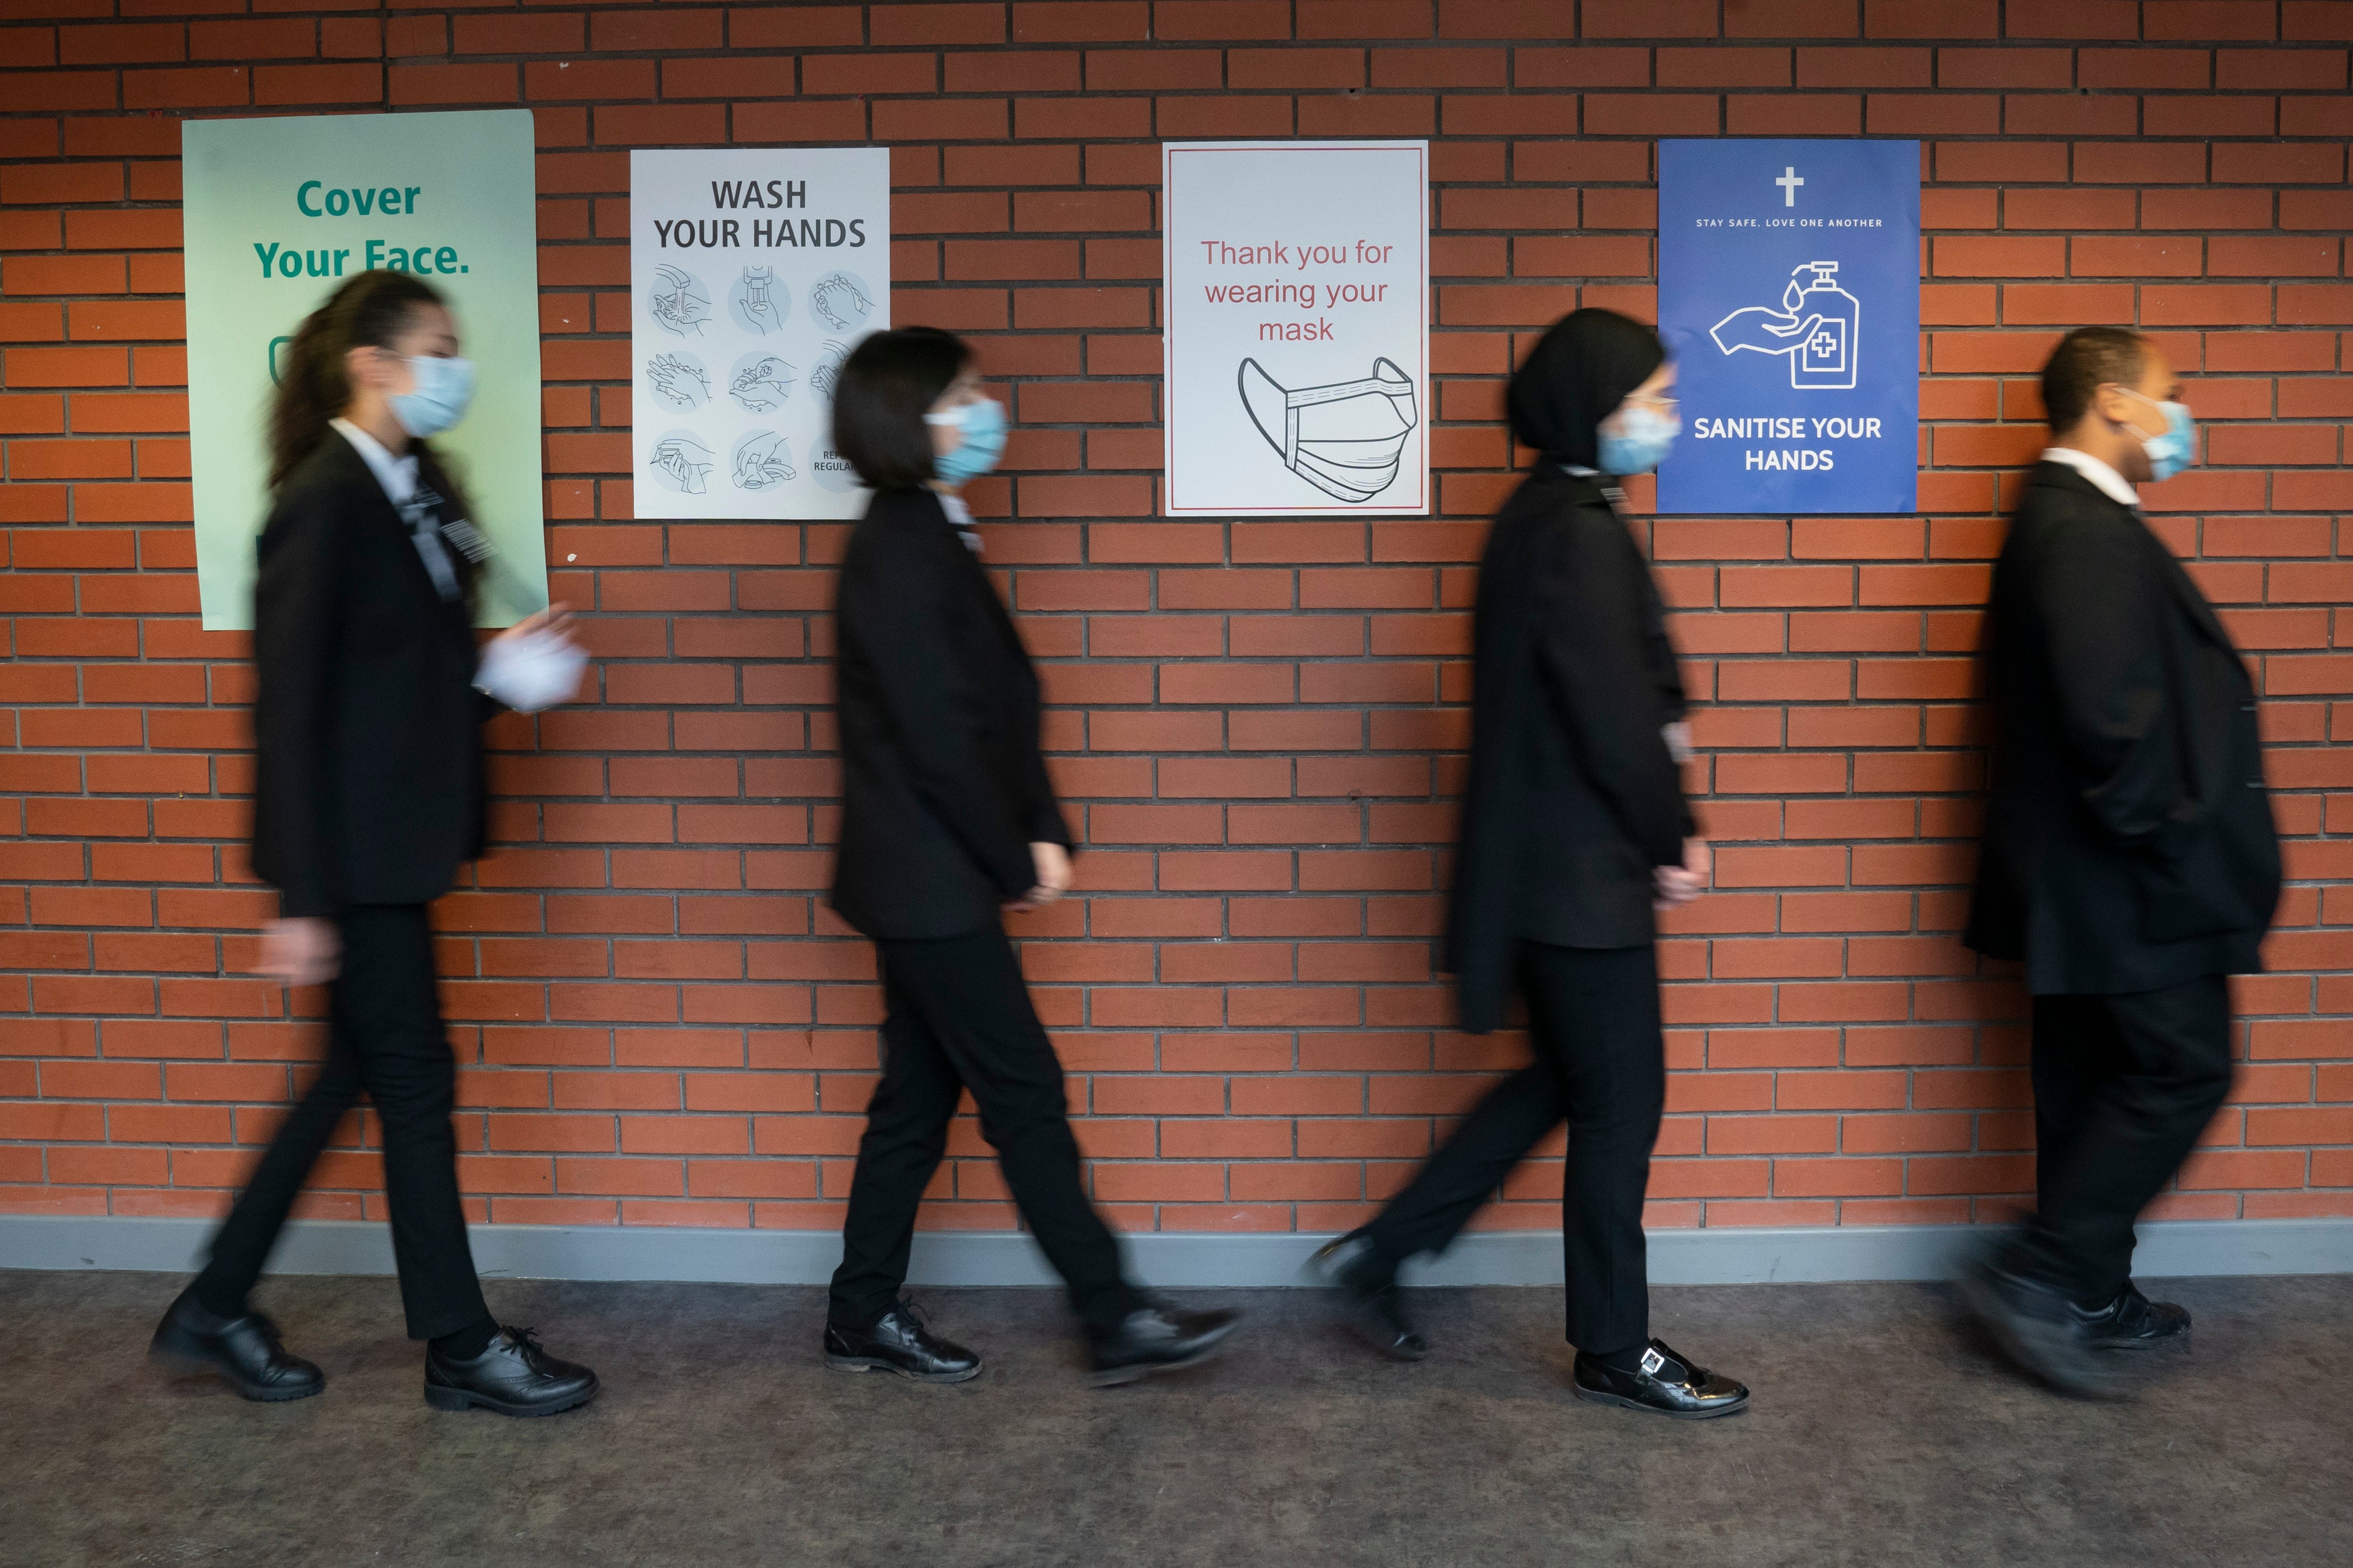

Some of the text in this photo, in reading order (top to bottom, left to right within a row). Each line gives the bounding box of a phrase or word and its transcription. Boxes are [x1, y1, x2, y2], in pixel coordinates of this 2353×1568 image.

[297, 180, 421, 217] Cover
[711, 181, 806, 208] WASH
[654, 219, 866, 248] YOUR HANDS
[253, 239, 469, 278] Your Face.
[1201, 239, 1393, 271] Thank you for
[1204, 279, 1388, 309] wearing your
[1260, 317, 1334, 341] mask
[1694, 418, 1882, 439] SANITISE YOUR
[1745, 450, 1834, 471] HANDS
